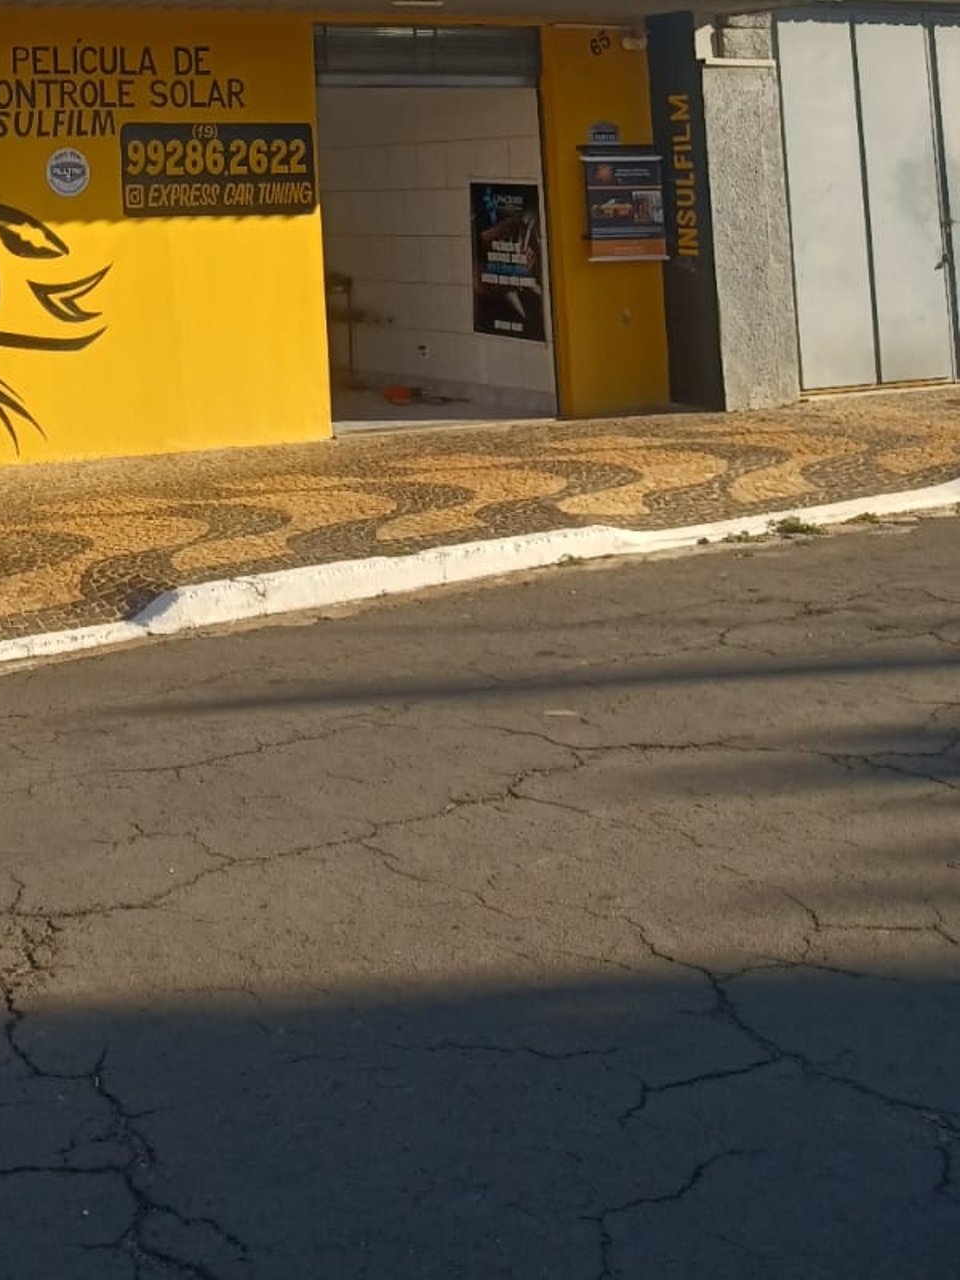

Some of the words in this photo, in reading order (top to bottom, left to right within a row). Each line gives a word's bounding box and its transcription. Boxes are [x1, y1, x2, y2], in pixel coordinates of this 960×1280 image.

[11, 38, 157, 76] PELÍCULA
[174, 46, 212, 76] DE
[149, 79, 245, 109] SOLAR
[191, 123, 219, 139] (19)
[667, 94, 700, 257] INSULFILM
[147, 182, 221, 208] EXPRESS
[223, 182, 255, 207] CAR
[257, 181, 313, 206] TUNING
